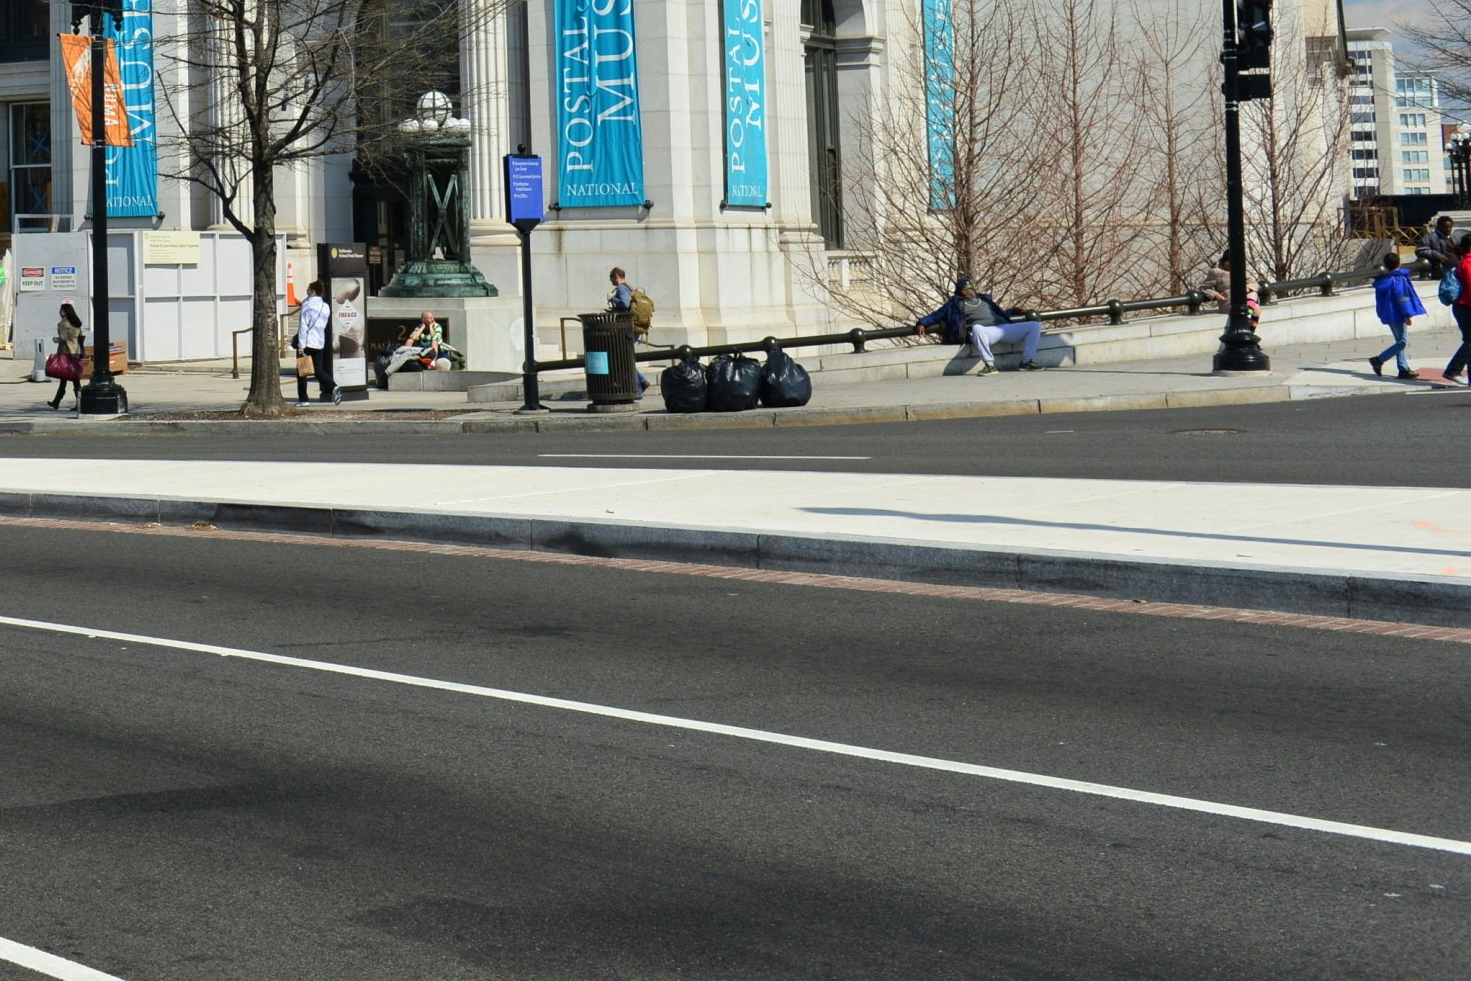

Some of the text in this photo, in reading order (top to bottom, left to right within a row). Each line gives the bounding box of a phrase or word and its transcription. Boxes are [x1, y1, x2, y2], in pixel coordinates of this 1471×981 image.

[562, 15, 593, 175] POSTAL
[728, 16, 746, 174] POSTAL
[566, 181, 638, 196] NATIONAL
[106, 195, 153, 207] ATIONAL
[397, 325, 407, 340] 2
